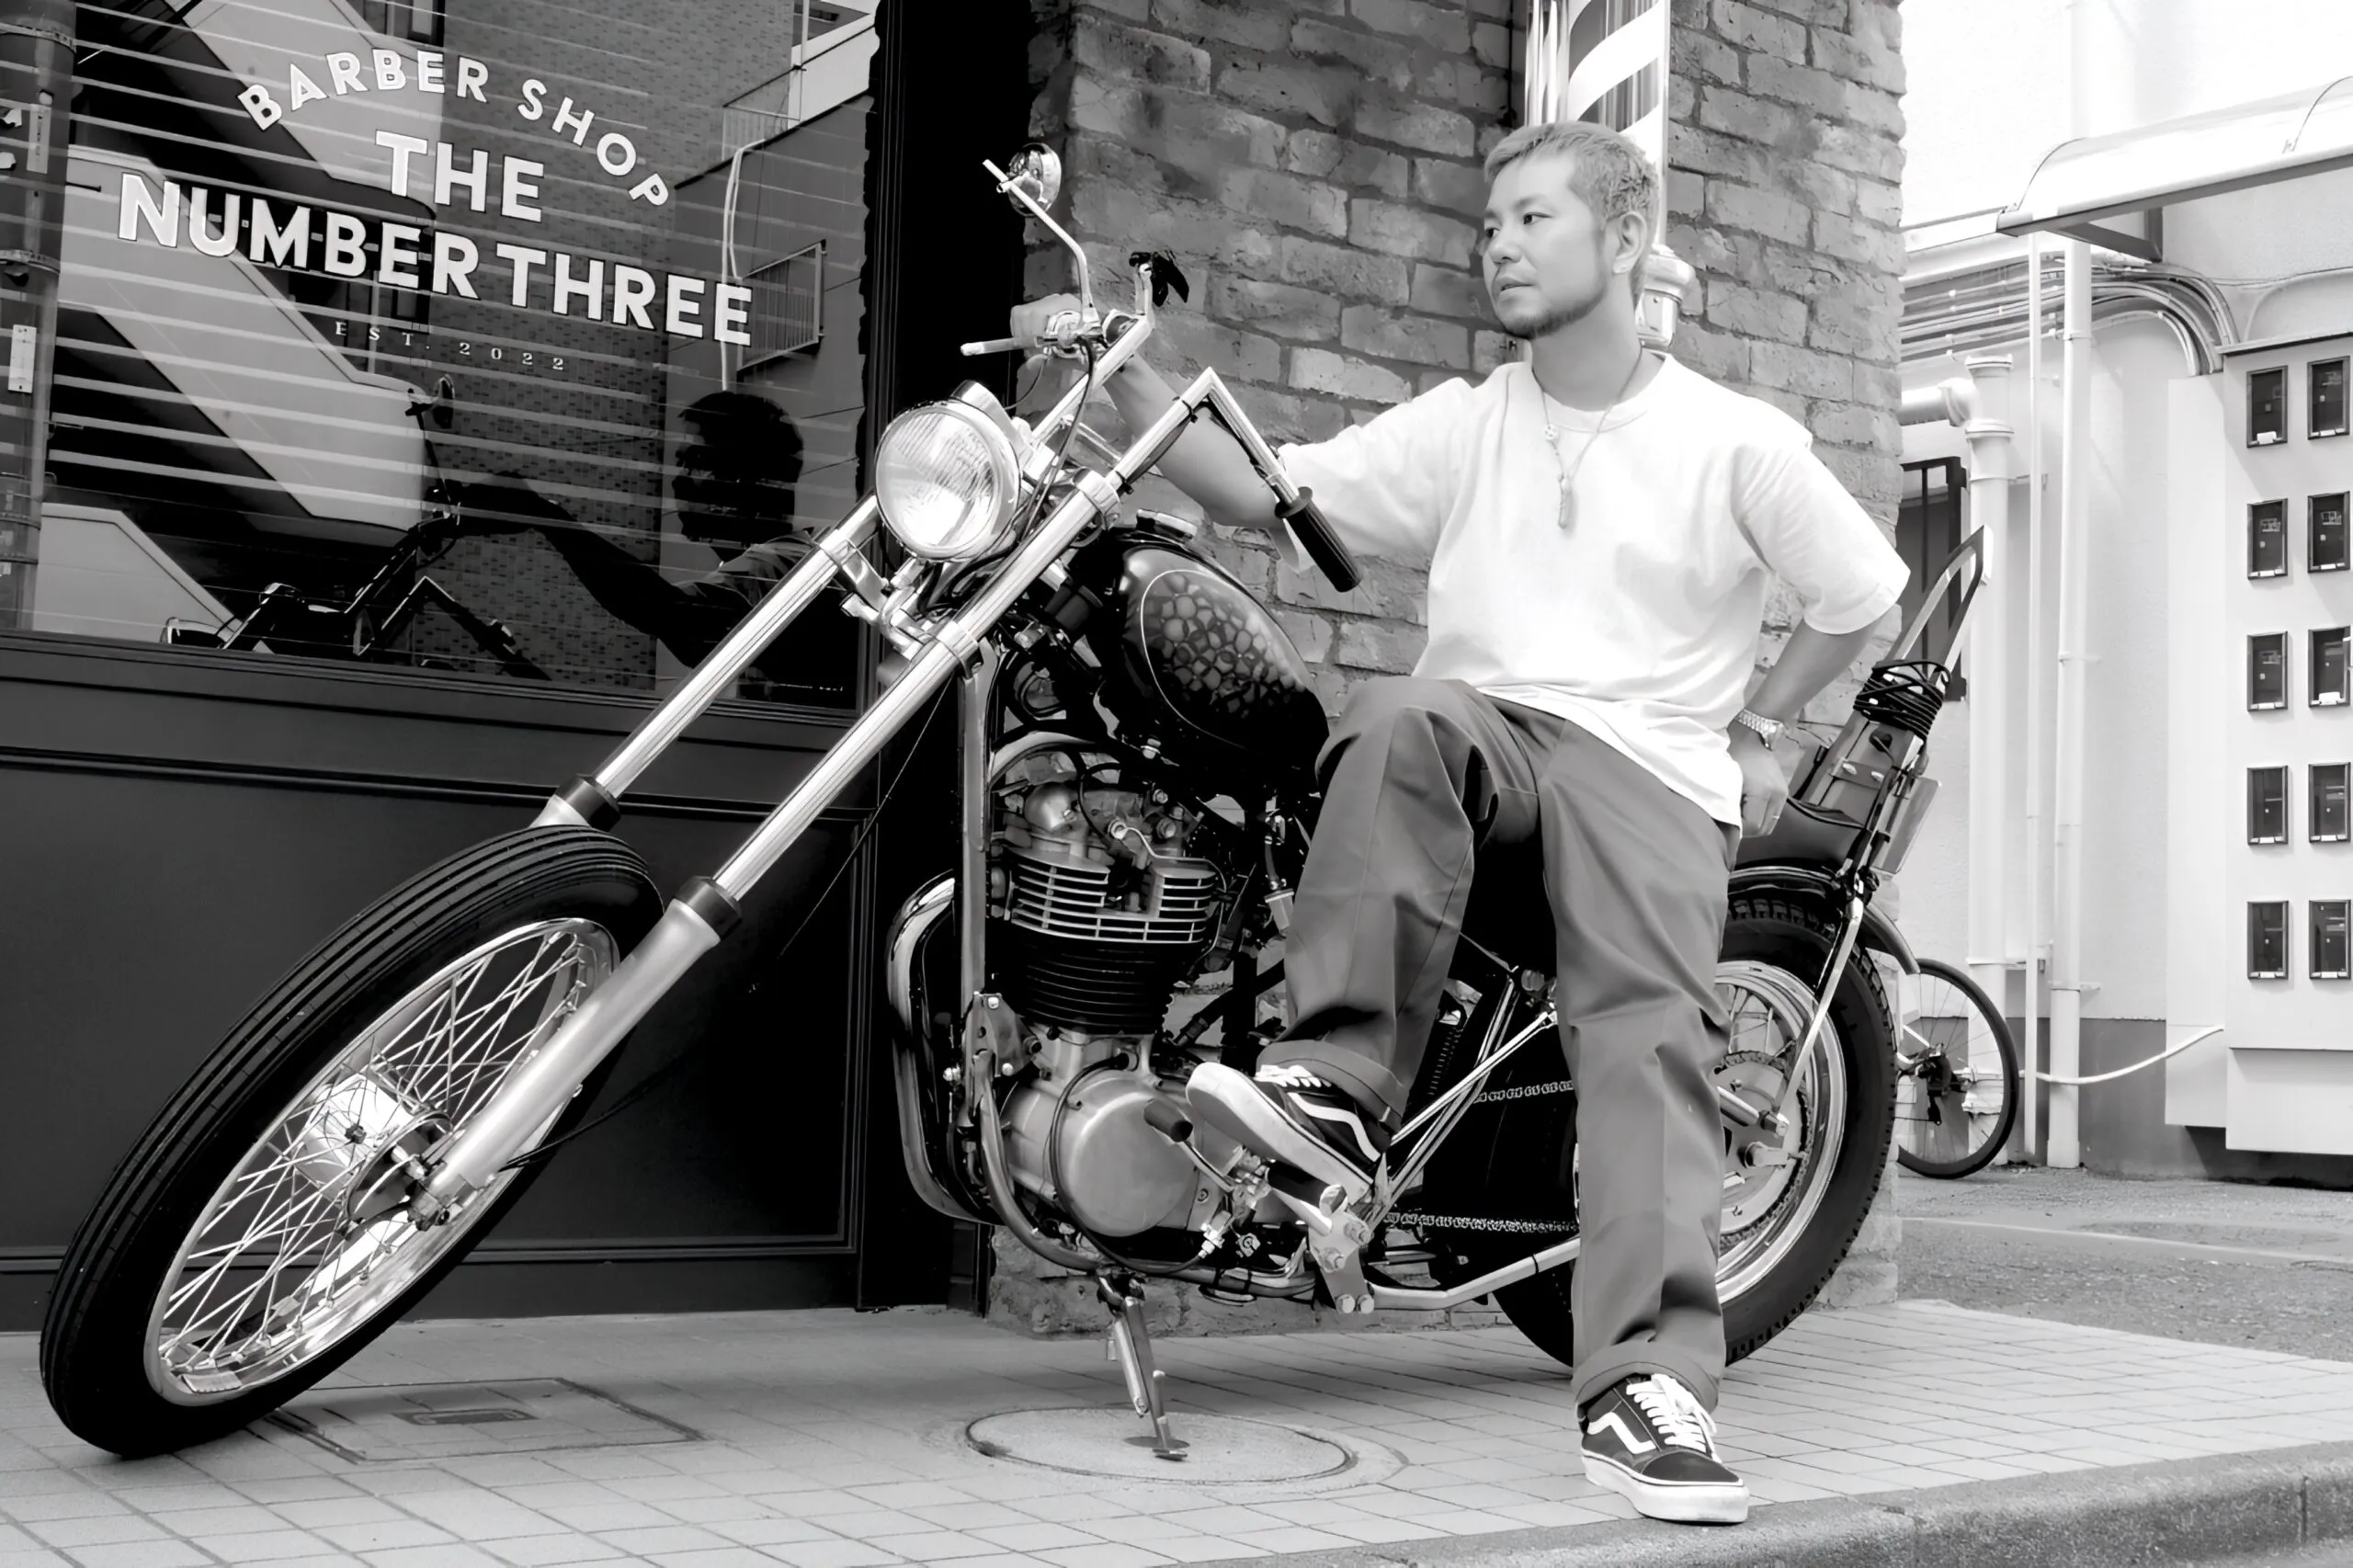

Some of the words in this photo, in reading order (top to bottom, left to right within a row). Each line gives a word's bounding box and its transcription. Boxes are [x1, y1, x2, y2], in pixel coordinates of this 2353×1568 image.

[238, 49, 488, 131] BARBER
[517, 79, 669, 206] SHOP
[375, 130, 544, 222] THE
[118, 172, 480, 300] NUMBER
[496, 242, 753, 347] THREE
[335, 322, 430, 349] EST.
[460, 342, 564, 370] 2022
